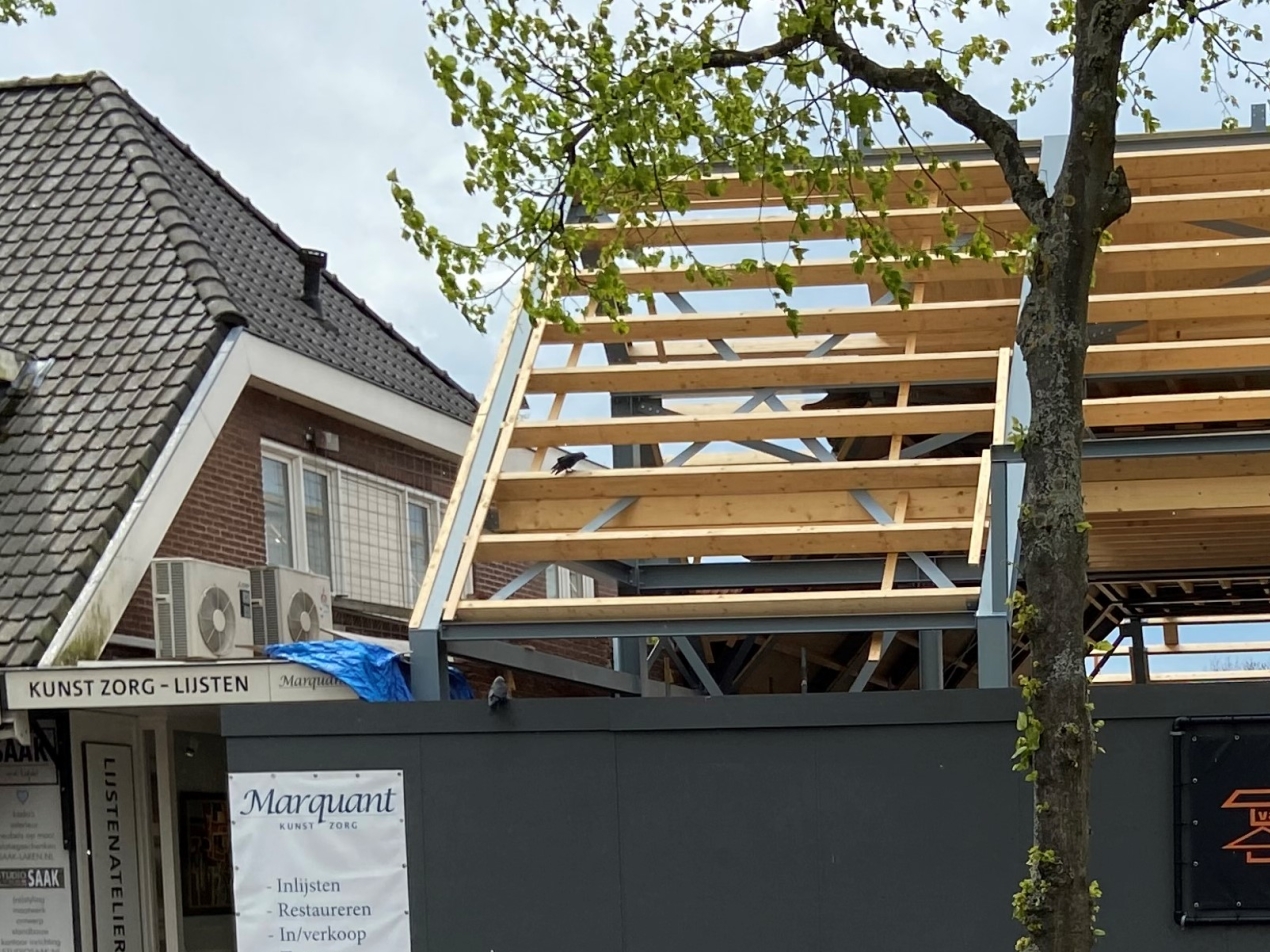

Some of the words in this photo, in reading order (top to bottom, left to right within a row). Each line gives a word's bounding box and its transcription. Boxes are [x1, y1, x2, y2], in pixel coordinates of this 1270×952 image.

[29, 680, 94, 698] KUNST
[100, 678, 155, 696] ZORG
[174, 675, 249, 694] LIJSTEN
[279, 675, 343, 690] Marquan
[240, 788, 397, 824] Marquant
[280, 822, 314, 830] KUNST
[329, 821, 358, 830] ZORG
[27, 869, 60, 887] SAAK
[277, 877, 341, 898] Inlijsten
[278, 902, 372, 917] Restaureren
[280, 925, 367, 945] In/verkoop
